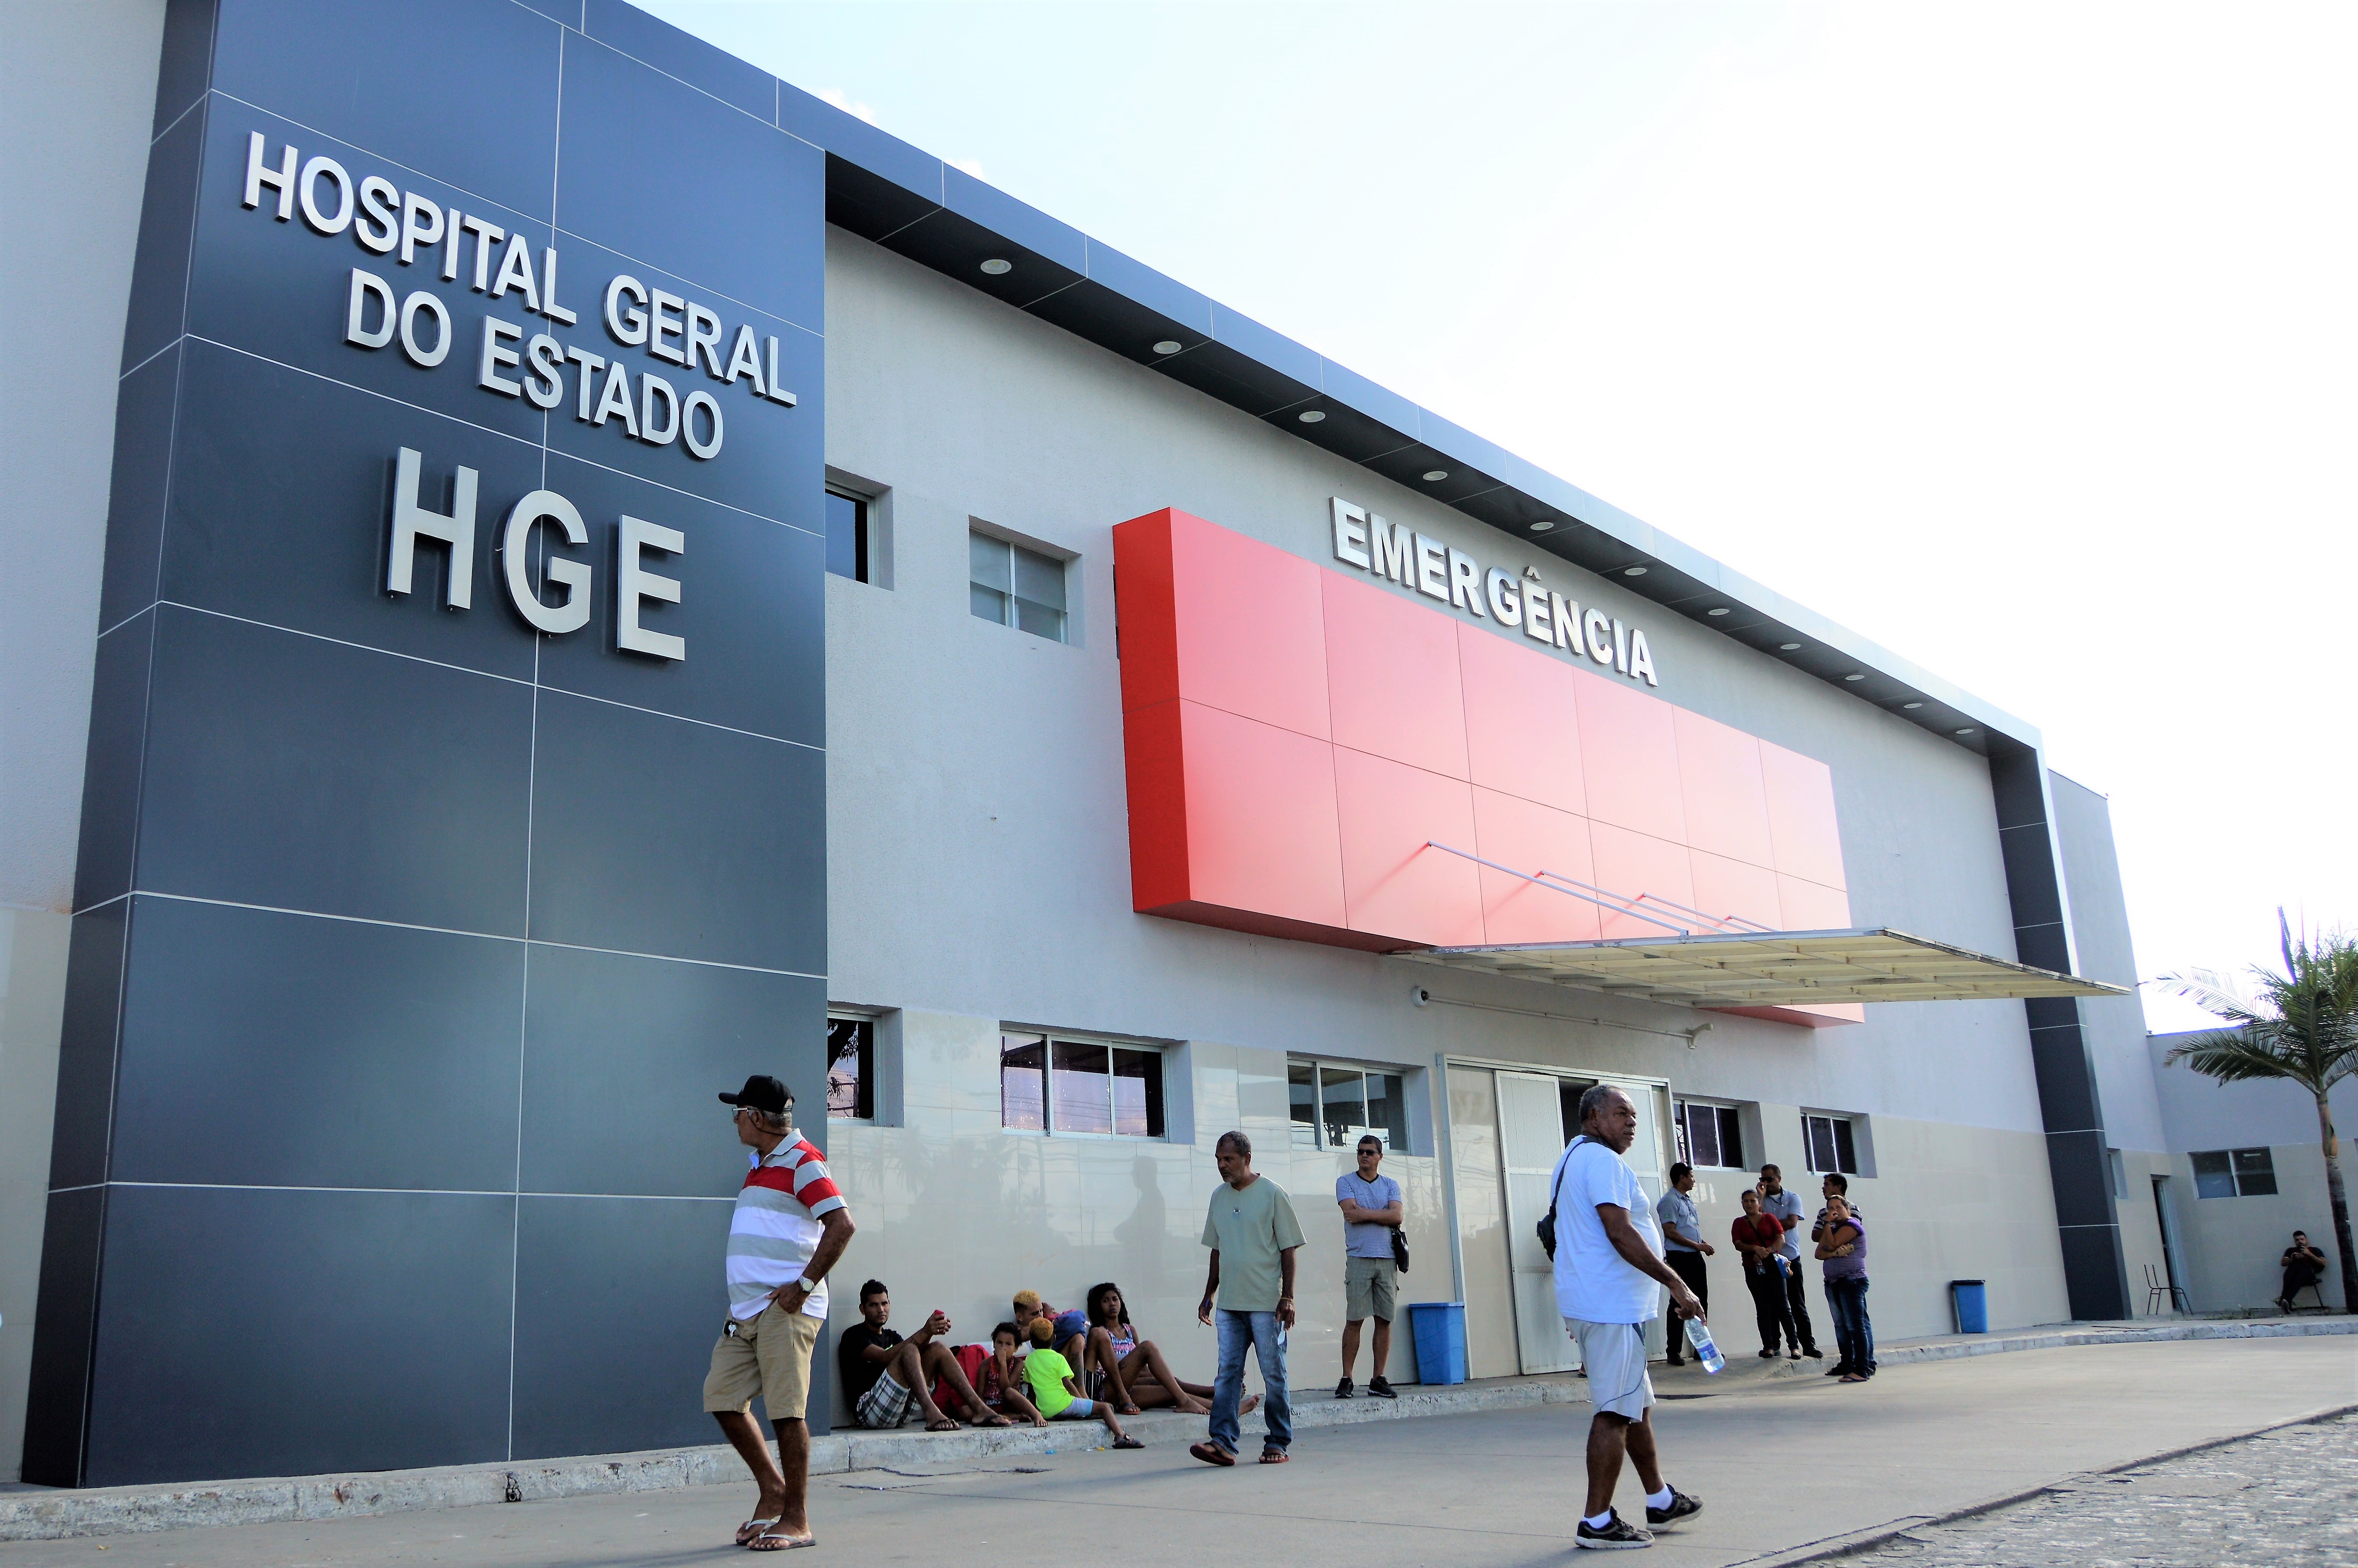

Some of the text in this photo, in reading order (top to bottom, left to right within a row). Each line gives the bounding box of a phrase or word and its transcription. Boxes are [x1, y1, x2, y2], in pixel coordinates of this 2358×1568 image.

[242, 131, 797, 407] HOSPITAL GERAL
[347, 268, 723, 459] DO ESTADO
[387, 446, 684, 661] HGE
[1329, 497, 1658, 687] EMERGÊNCIA
